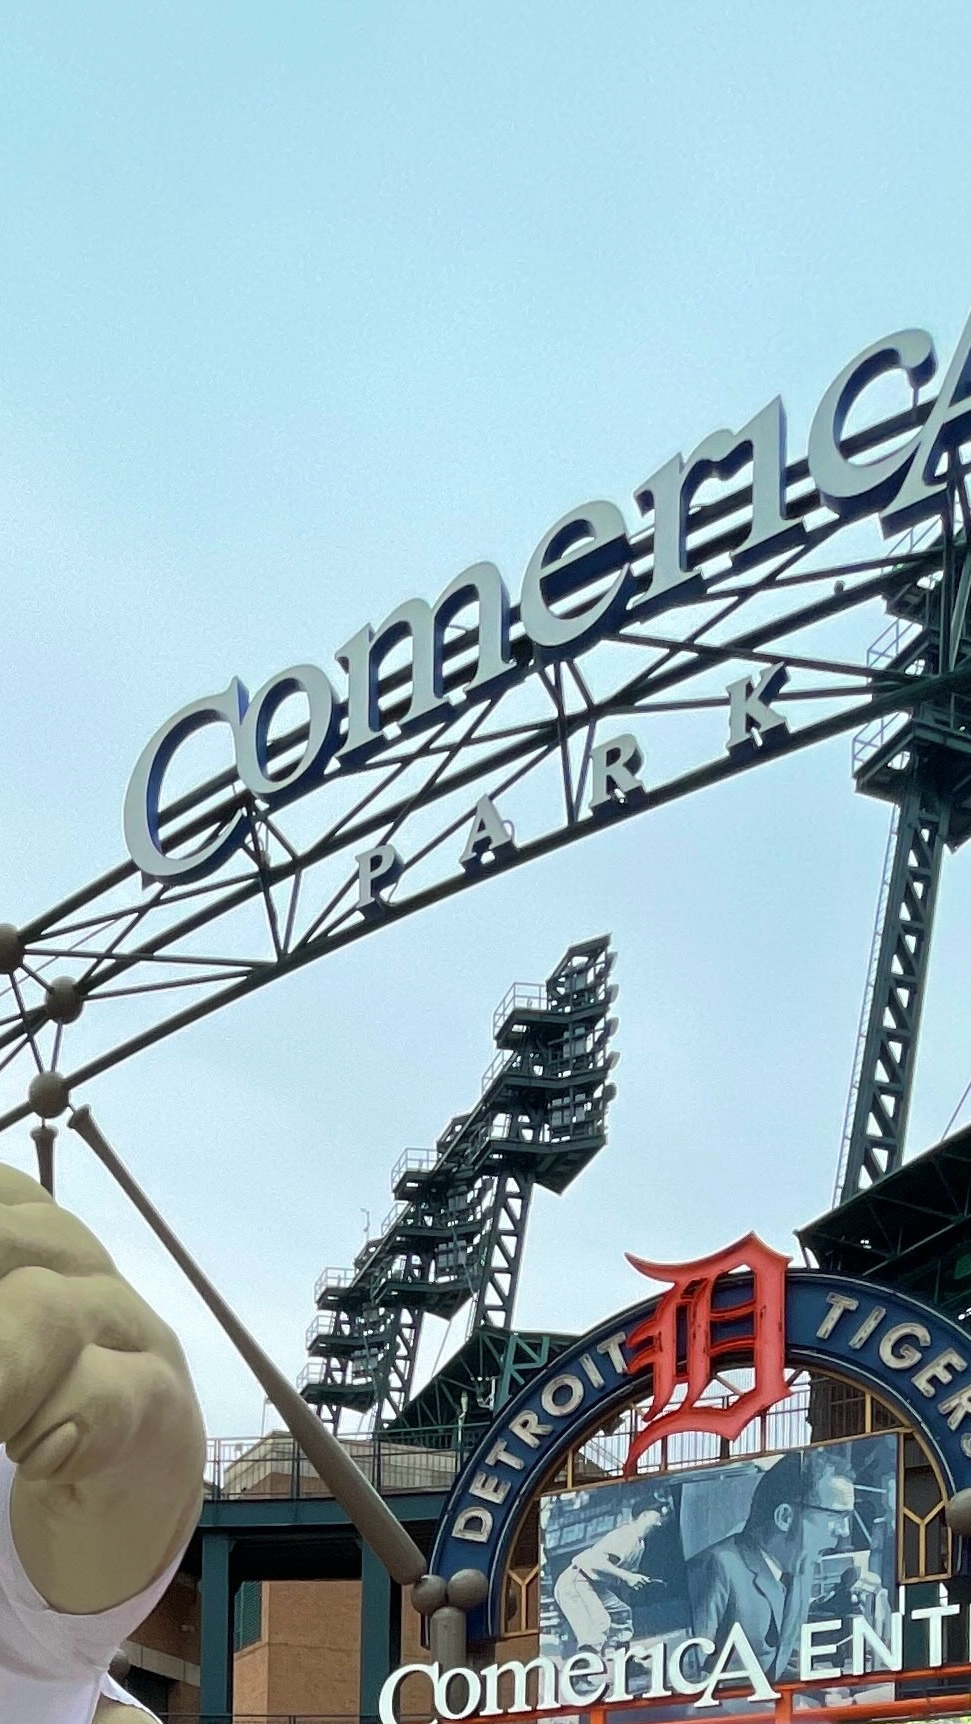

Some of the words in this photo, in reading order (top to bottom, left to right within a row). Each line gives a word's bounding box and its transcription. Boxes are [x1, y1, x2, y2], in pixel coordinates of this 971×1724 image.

[353, 661, 790, 914] PARK
[451, 1331, 627, 1544] DETROIT
[816, 1291, 971, 1458] TIGER
[623, 1230, 794, 1481] D
[800, 1603, 971, 1681] ENT
